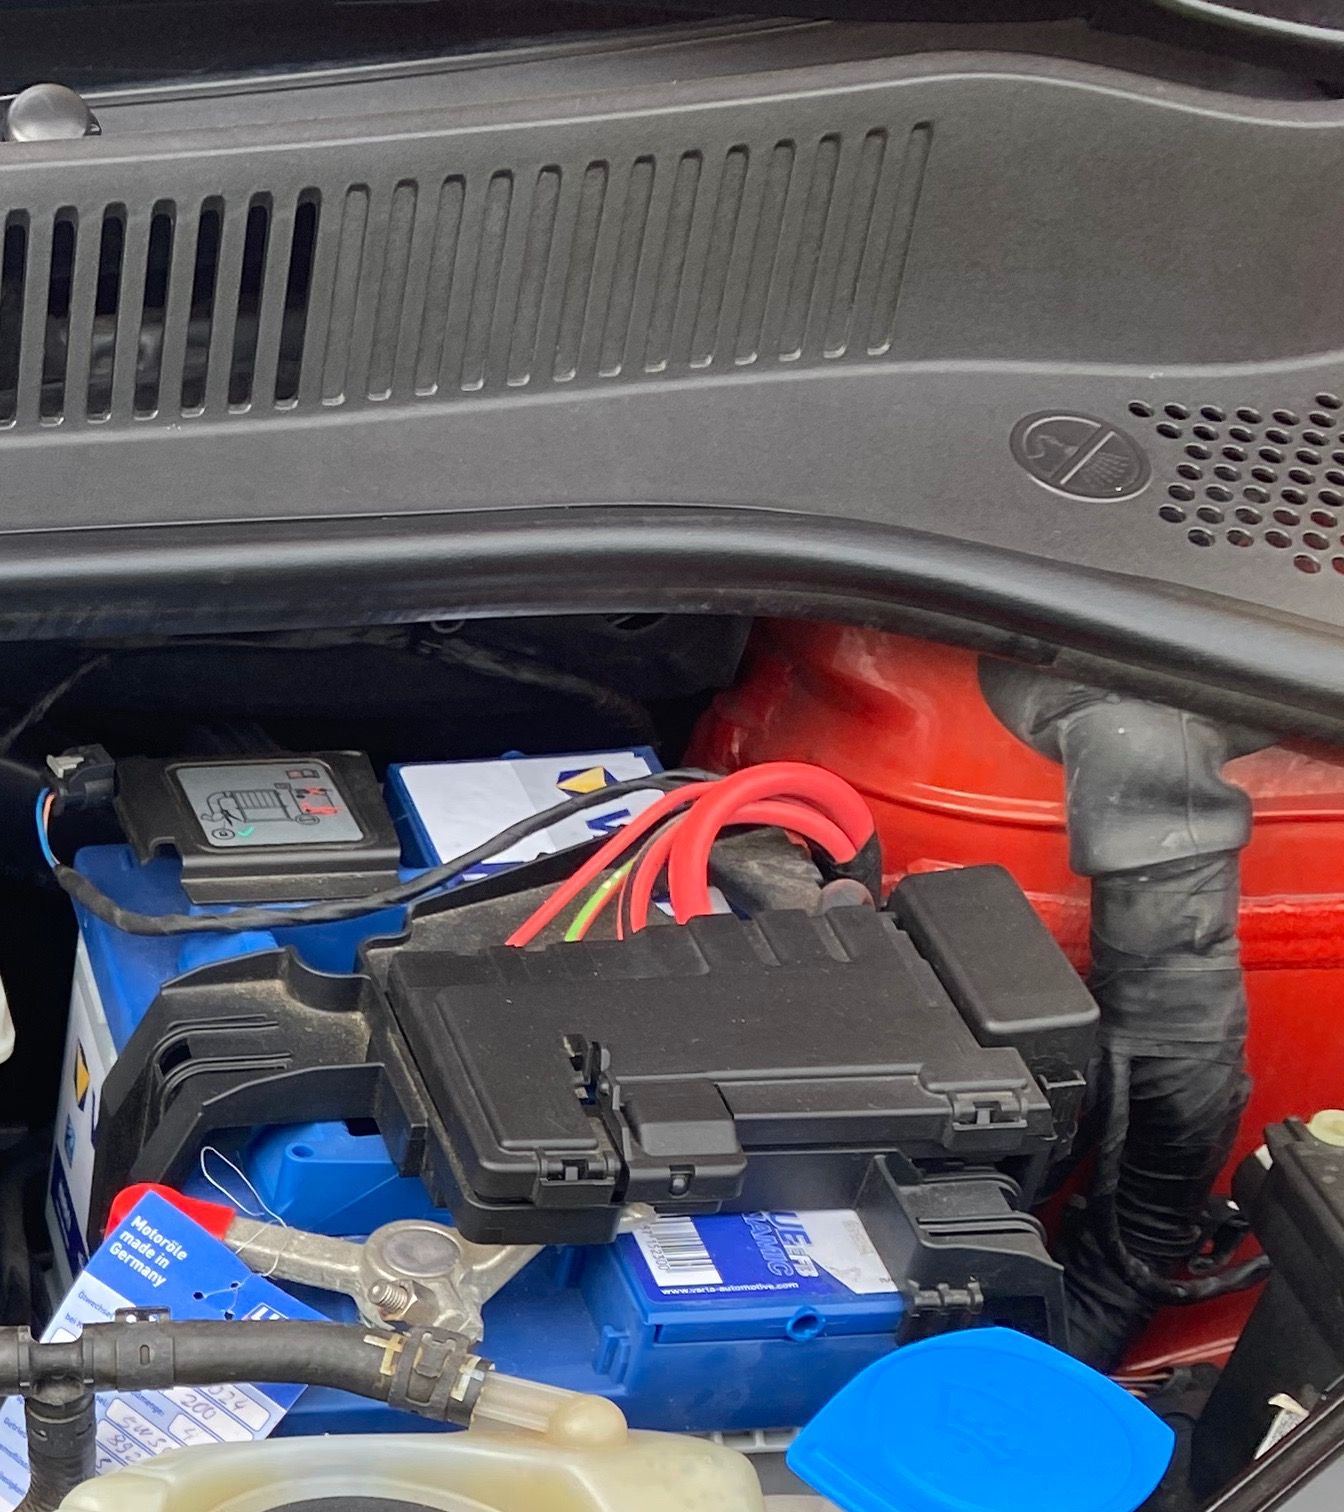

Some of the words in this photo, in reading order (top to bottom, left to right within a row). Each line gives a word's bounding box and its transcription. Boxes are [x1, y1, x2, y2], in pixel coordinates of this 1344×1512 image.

[119, 1230, 155, 1260] made
[154, 1252, 170, 1269] in
[130, 1215, 188, 1261] Motoröle
[768, 1212, 813, 1252] UE
[109, 1242, 167, 1288] Germany
[662, 1282, 799, 1295] www.varta-automotive.com
[181, 1394, 216, 1420] 200
